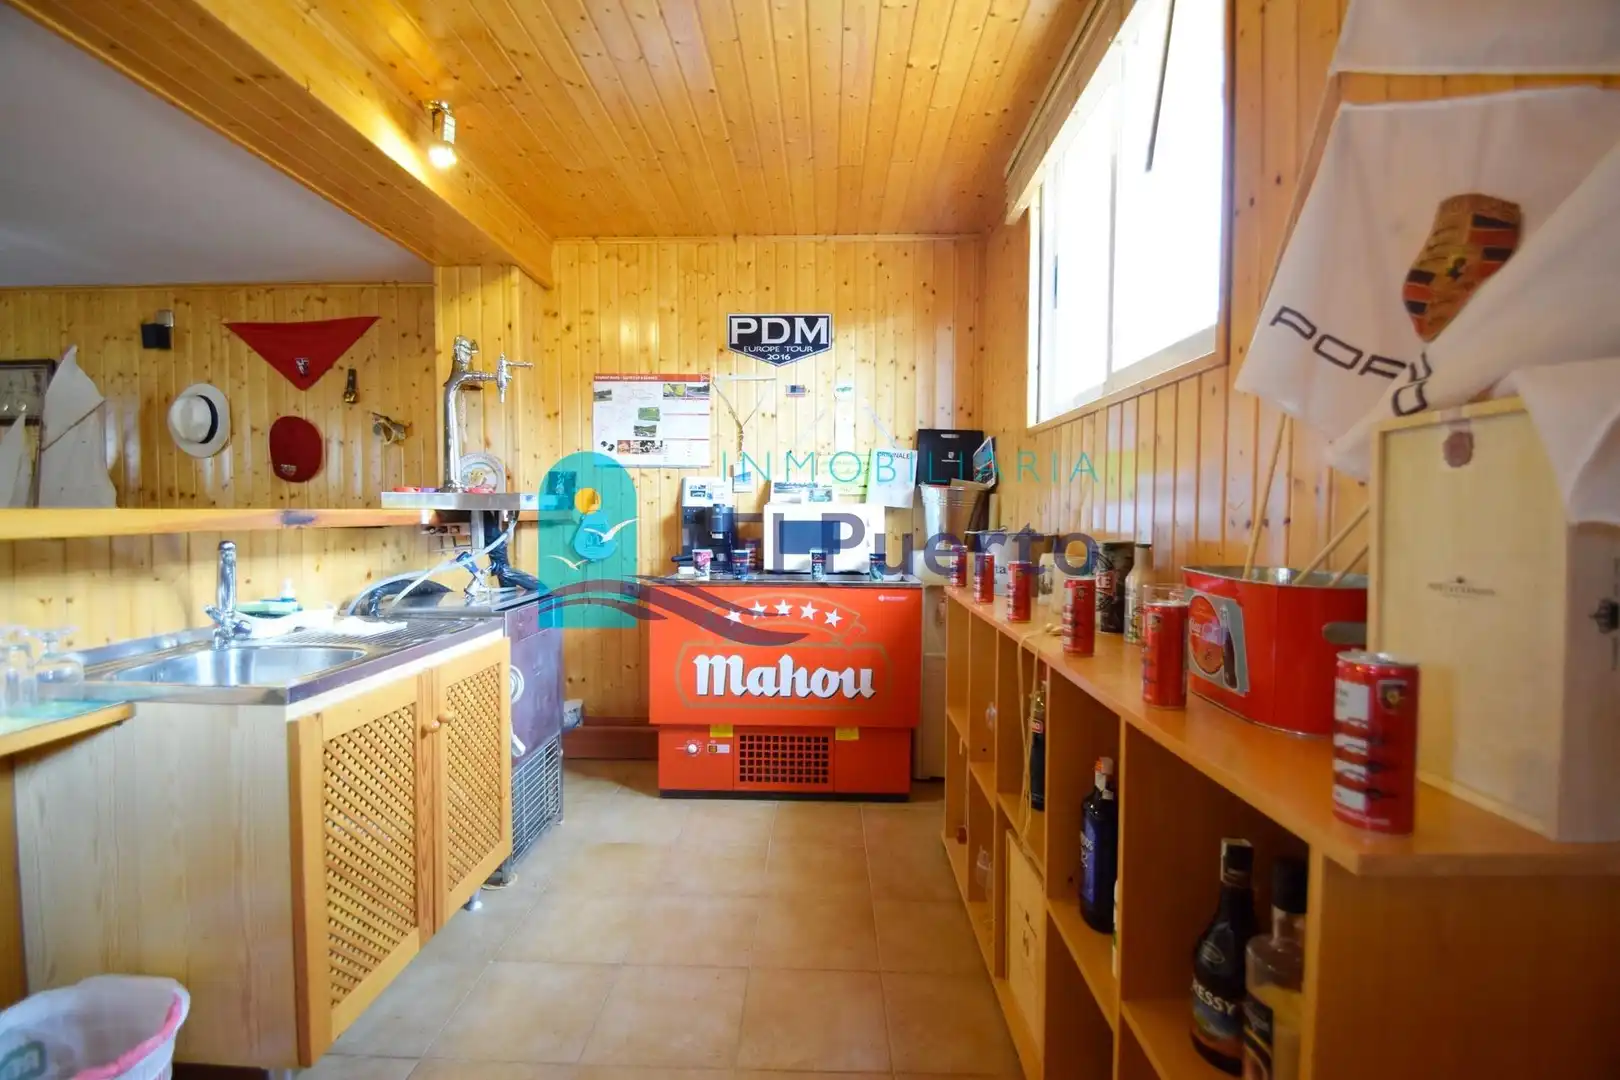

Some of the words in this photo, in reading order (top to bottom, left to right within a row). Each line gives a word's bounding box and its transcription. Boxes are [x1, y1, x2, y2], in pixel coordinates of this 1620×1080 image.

[730, 317, 828, 344] PDM
[743, 345, 780, 353] EUROPE
[784, 345, 814, 353] TOUR
[767, 353, 791, 361] 2016
[692, 653, 877, 699] Mahou
